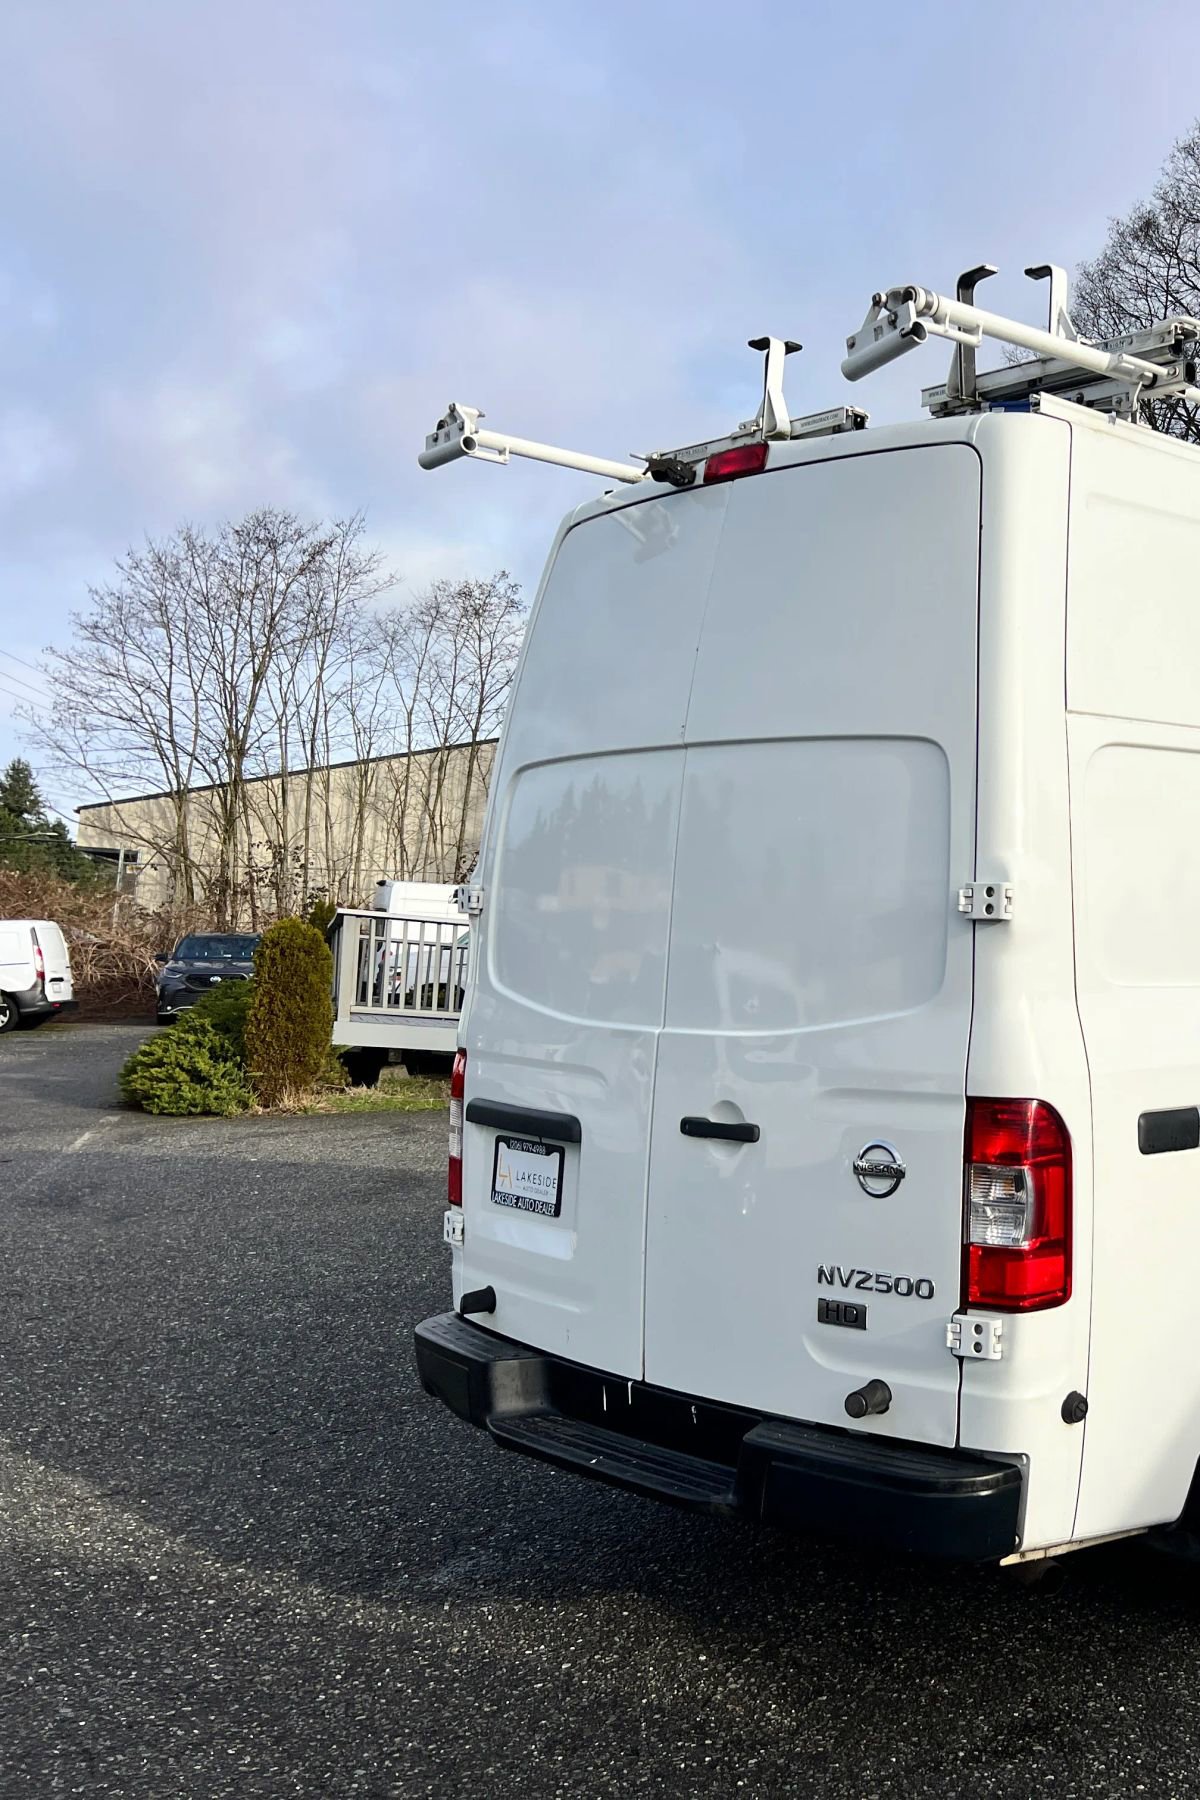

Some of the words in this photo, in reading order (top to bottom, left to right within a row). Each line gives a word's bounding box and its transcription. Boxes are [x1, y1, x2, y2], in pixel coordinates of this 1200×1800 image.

[516, 1169, 558, 1189] LAKESIDE
[856, 1163, 898, 1175] NISSAN
[492, 1191, 517, 1207] LAKESIDE
[517, 1197, 535, 1211] AUTO
[535, 1201, 555, 1216] DEALER
[817, 1264, 936, 1300] NV2500
[825, 1301, 859, 1324] HD
